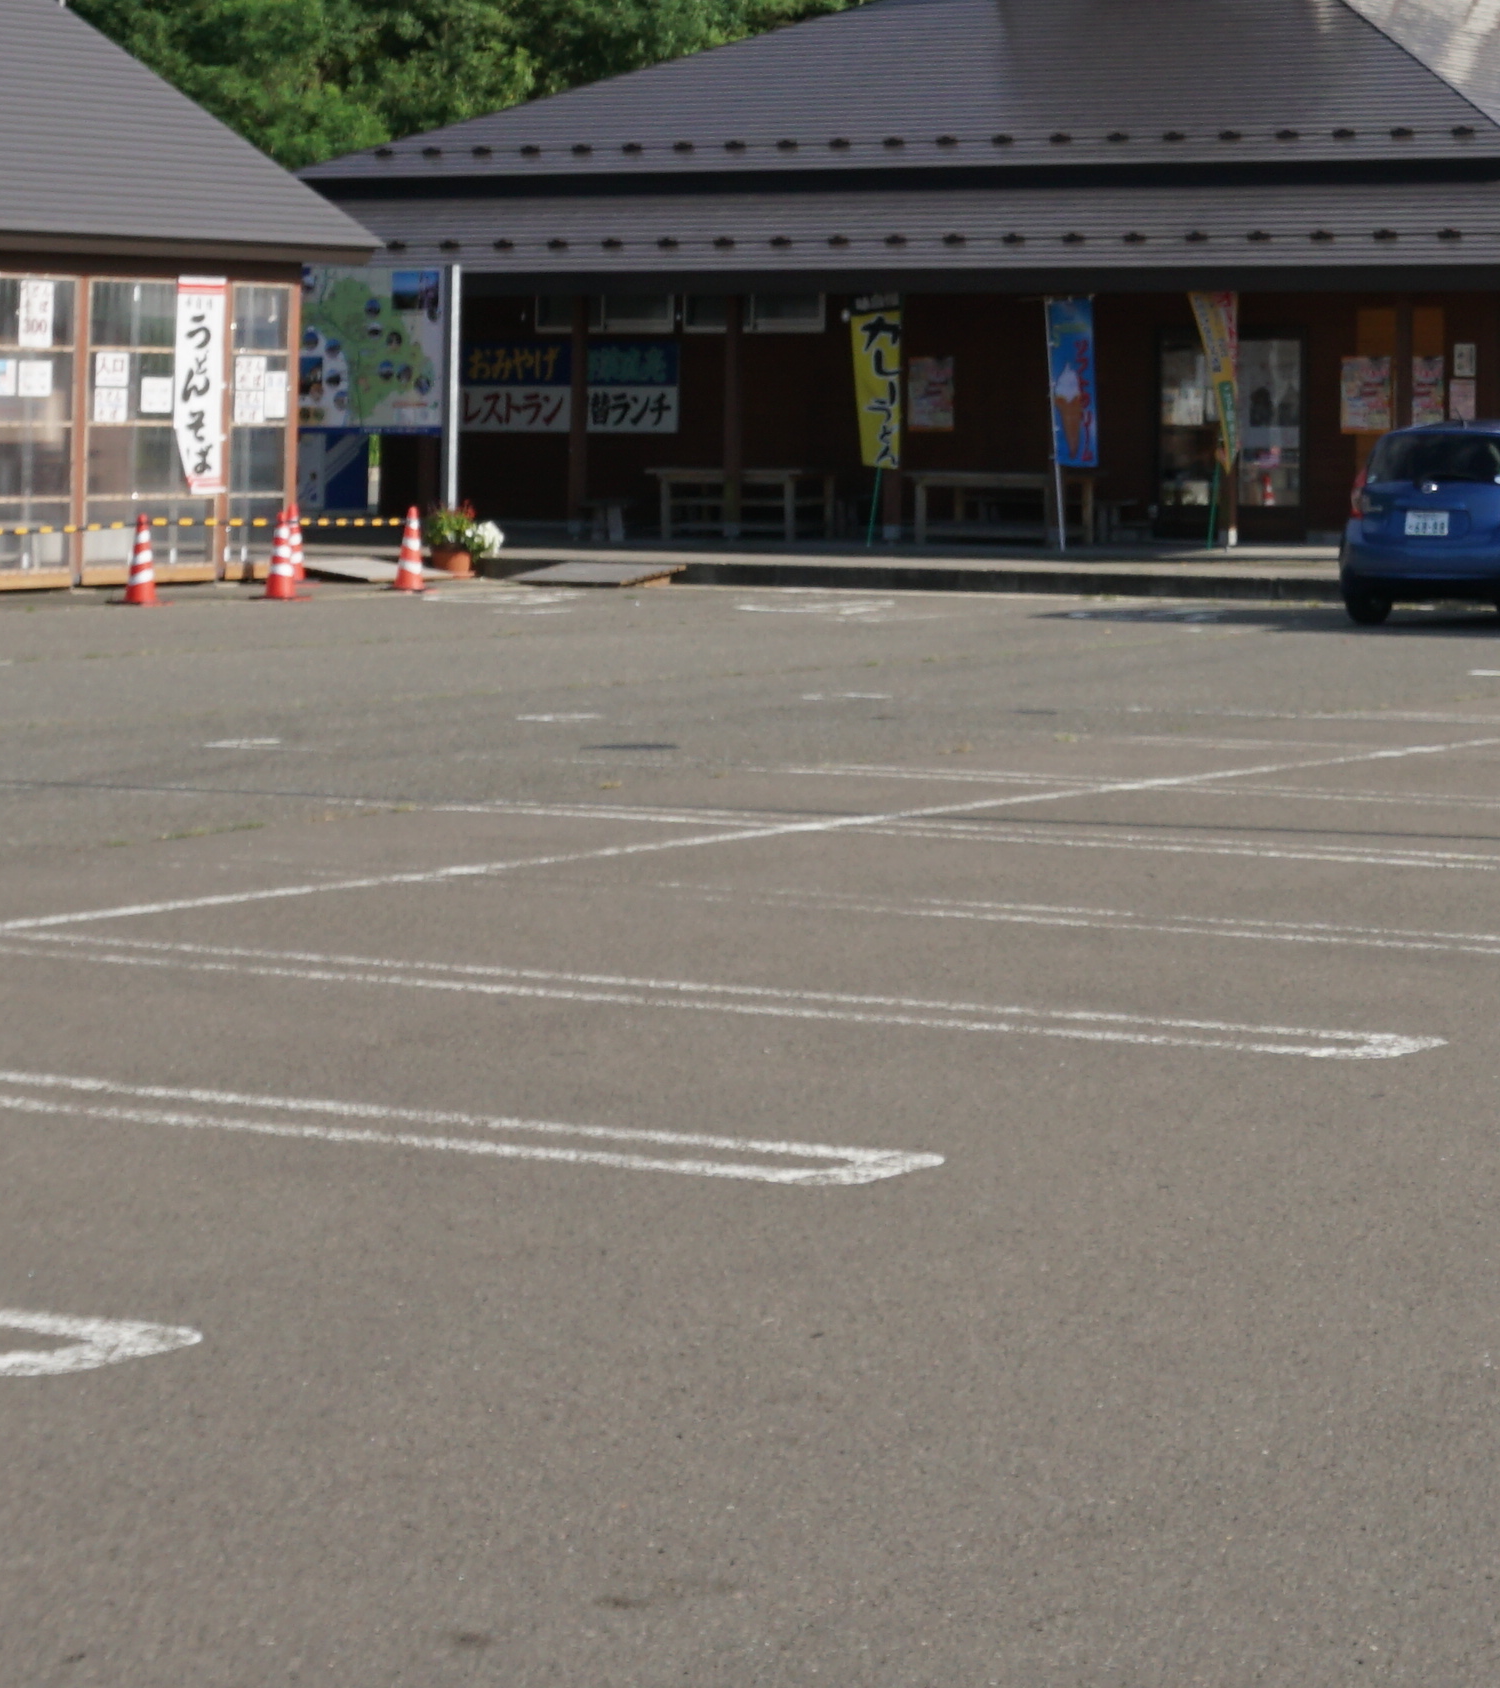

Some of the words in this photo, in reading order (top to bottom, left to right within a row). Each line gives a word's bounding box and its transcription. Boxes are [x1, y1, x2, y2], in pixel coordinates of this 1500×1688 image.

[463, 393, 564, 425] レストラン
